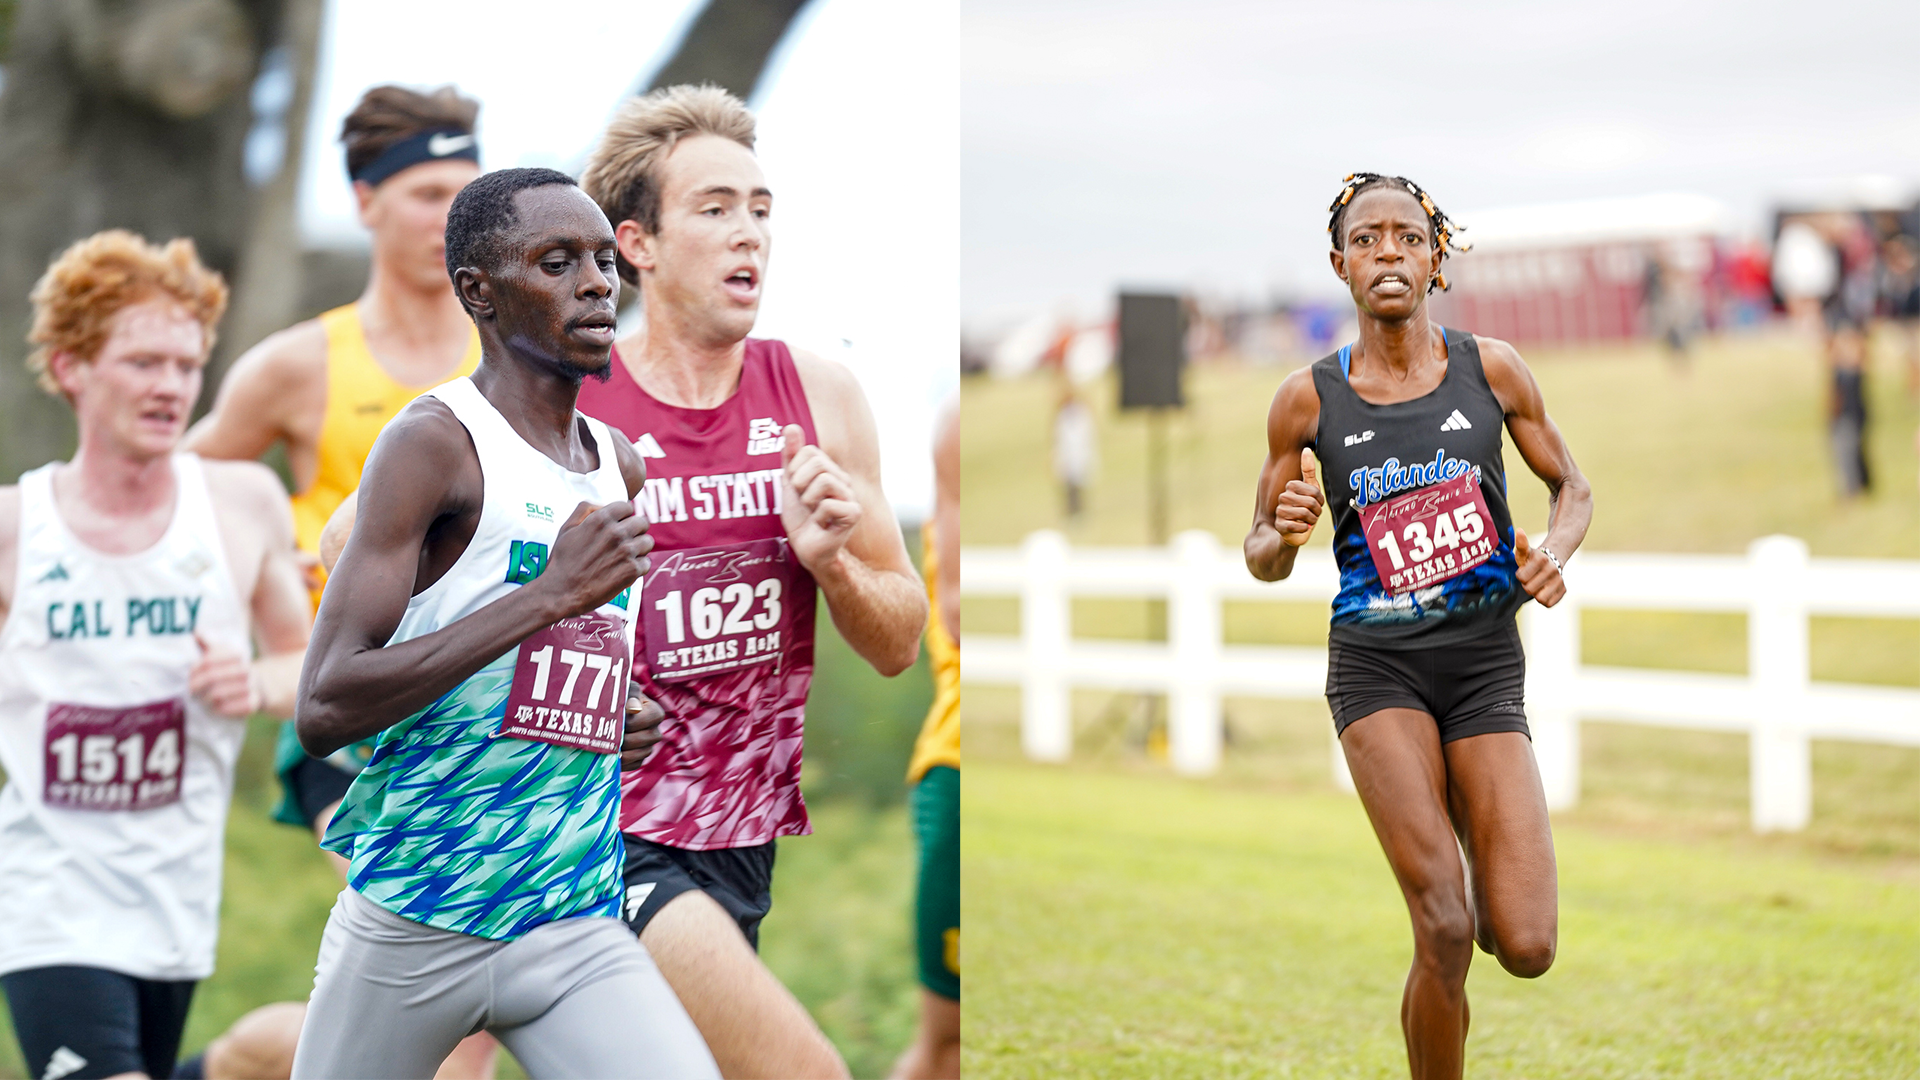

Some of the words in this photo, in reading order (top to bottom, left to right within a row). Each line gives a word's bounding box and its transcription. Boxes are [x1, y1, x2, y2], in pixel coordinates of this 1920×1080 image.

[1378, 501, 1484, 572] 1345
[1403, 553, 1456, 584] TEXAS
[1460, 536, 1492, 563] A&M
[47, 602, 111, 639] CAL
[126, 597, 202, 637] POLY
[655, 578, 782, 643] 1623
[677, 639, 738, 667] TEXAS
[744, 631, 781, 656] A&M
[530, 645, 624, 714] 1771
[535, 706, 593, 735] TEXAS
[595, 717, 617, 740] A&M
[50, 728, 180, 783] 1514
